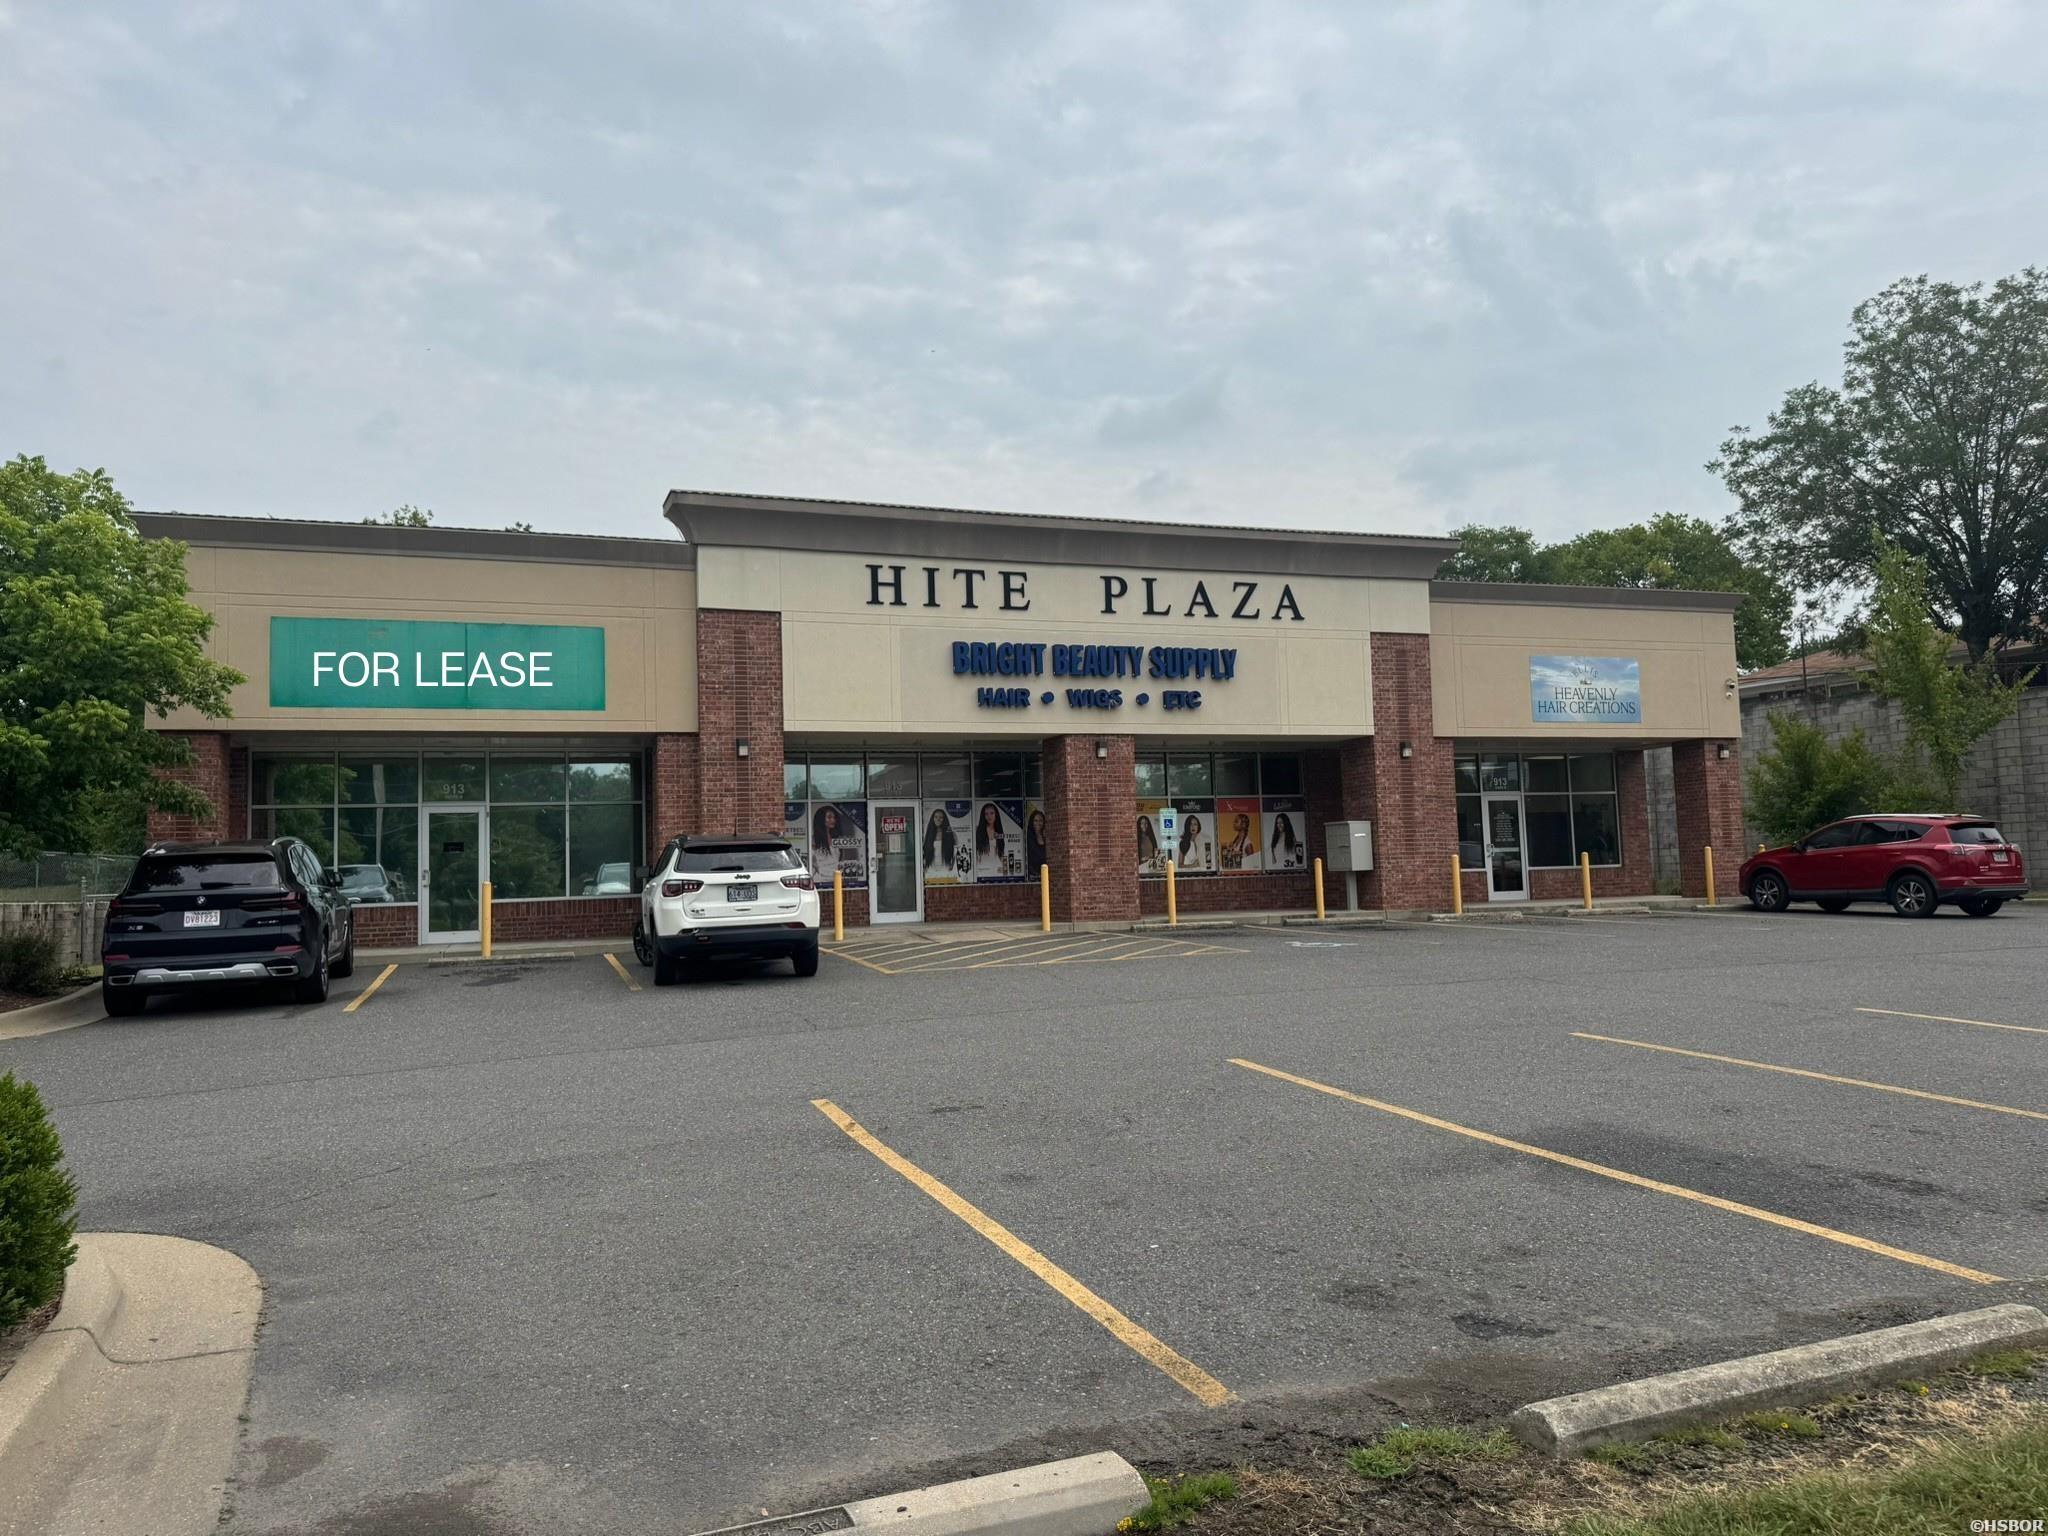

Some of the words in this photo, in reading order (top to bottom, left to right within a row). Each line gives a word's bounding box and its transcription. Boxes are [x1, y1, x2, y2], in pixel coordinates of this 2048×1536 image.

[865, 564, 1031, 611] HITE
[1099, 575, 1305, 621] PLAZA
[952, 640, 1047, 675] BRIGHT
[1051, 643, 1144, 678] BEAUTY
[1148, 646, 1237, 680] SUPPLY
[312, 651, 400, 687] FOR
[415, 651, 553, 687] LEASE
[977, 687, 1031, 708] HAIR
[1065, 688, 1123, 710] WIGS
[1162, 690, 1202, 710] ETC
[1554, 687, 1618, 701] HEAVENLY
[1538, 700, 1567, 713] HAIR
[1569, 701, 1636, 714] CREATIONS
[442, 783, 465, 794] 913
[1493, 777, 1508, 786] 913
[884, 823, 904, 832] OPEN
[832, 838, 863, 846] GLOSSY
